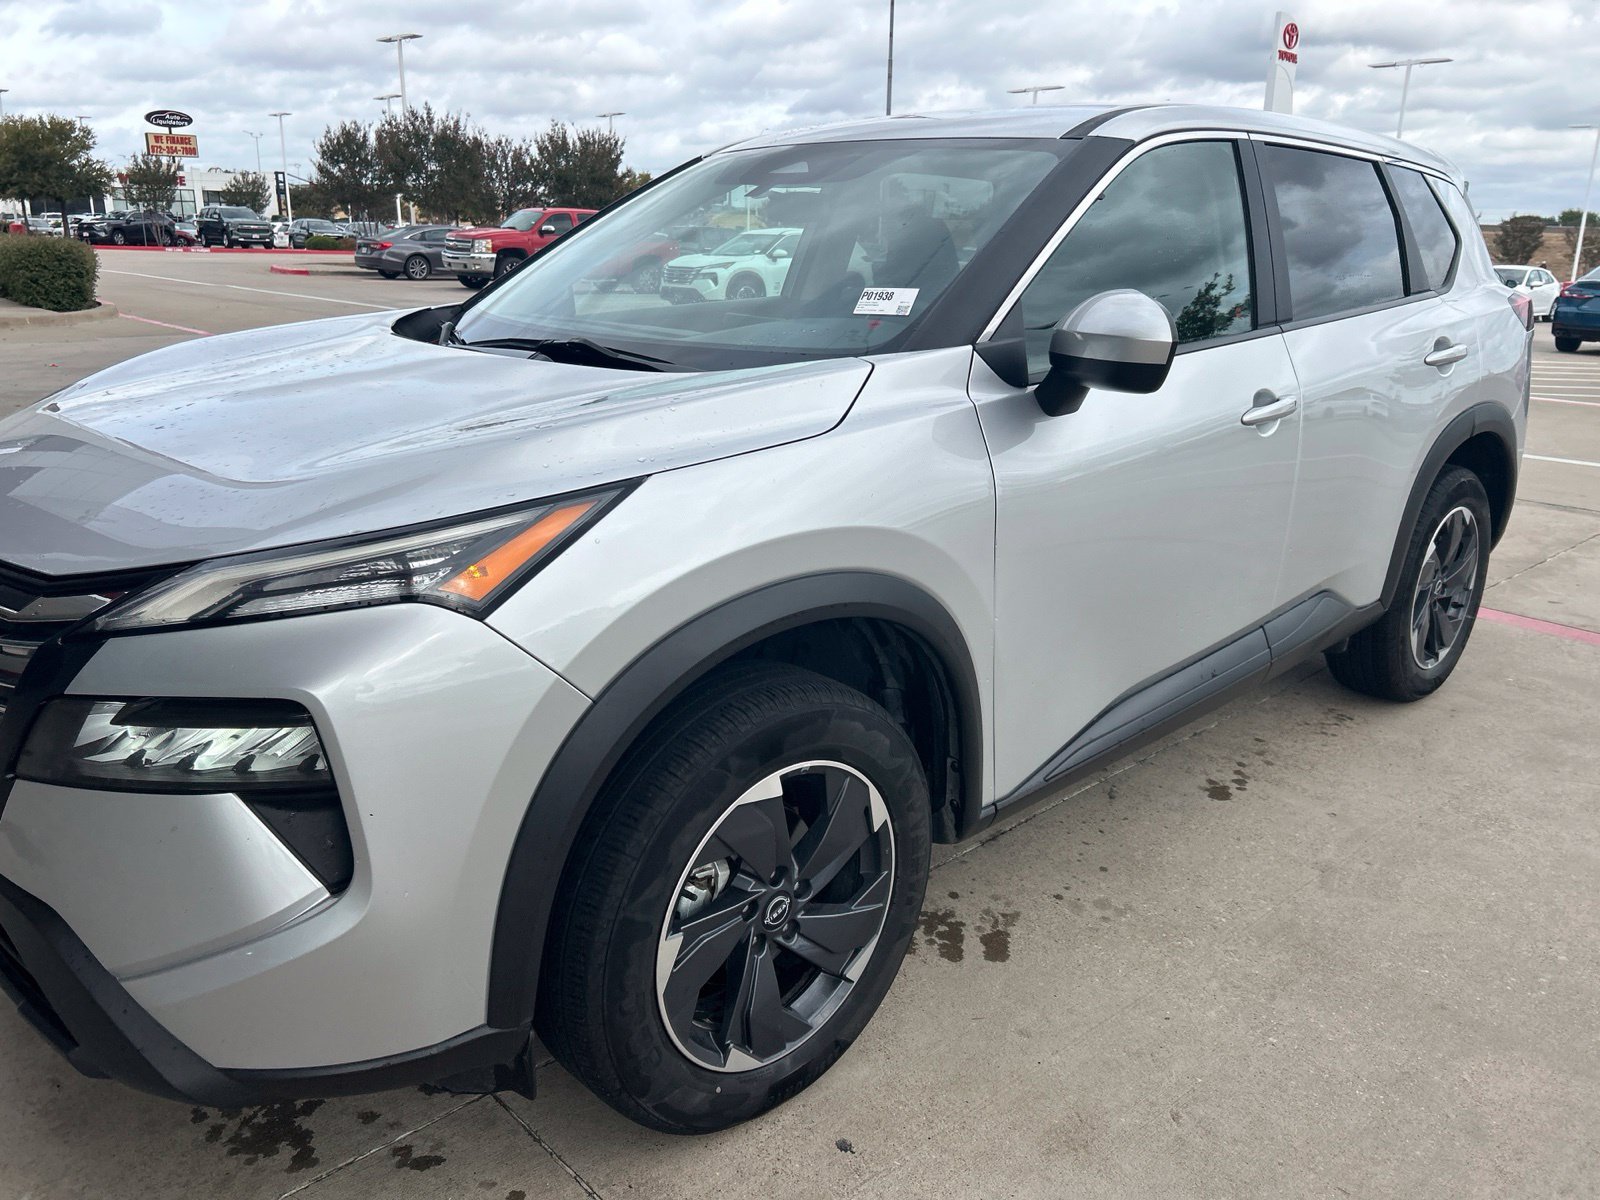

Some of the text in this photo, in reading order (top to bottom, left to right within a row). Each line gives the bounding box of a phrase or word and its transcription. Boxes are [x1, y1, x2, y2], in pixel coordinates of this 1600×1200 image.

[1278, 50, 1297, 64] TOYOTA
[154, 135, 192, 146] WE FINANCE
[861, 291, 895, 301] P01938
[764, 897, 790, 924] NISSAN
